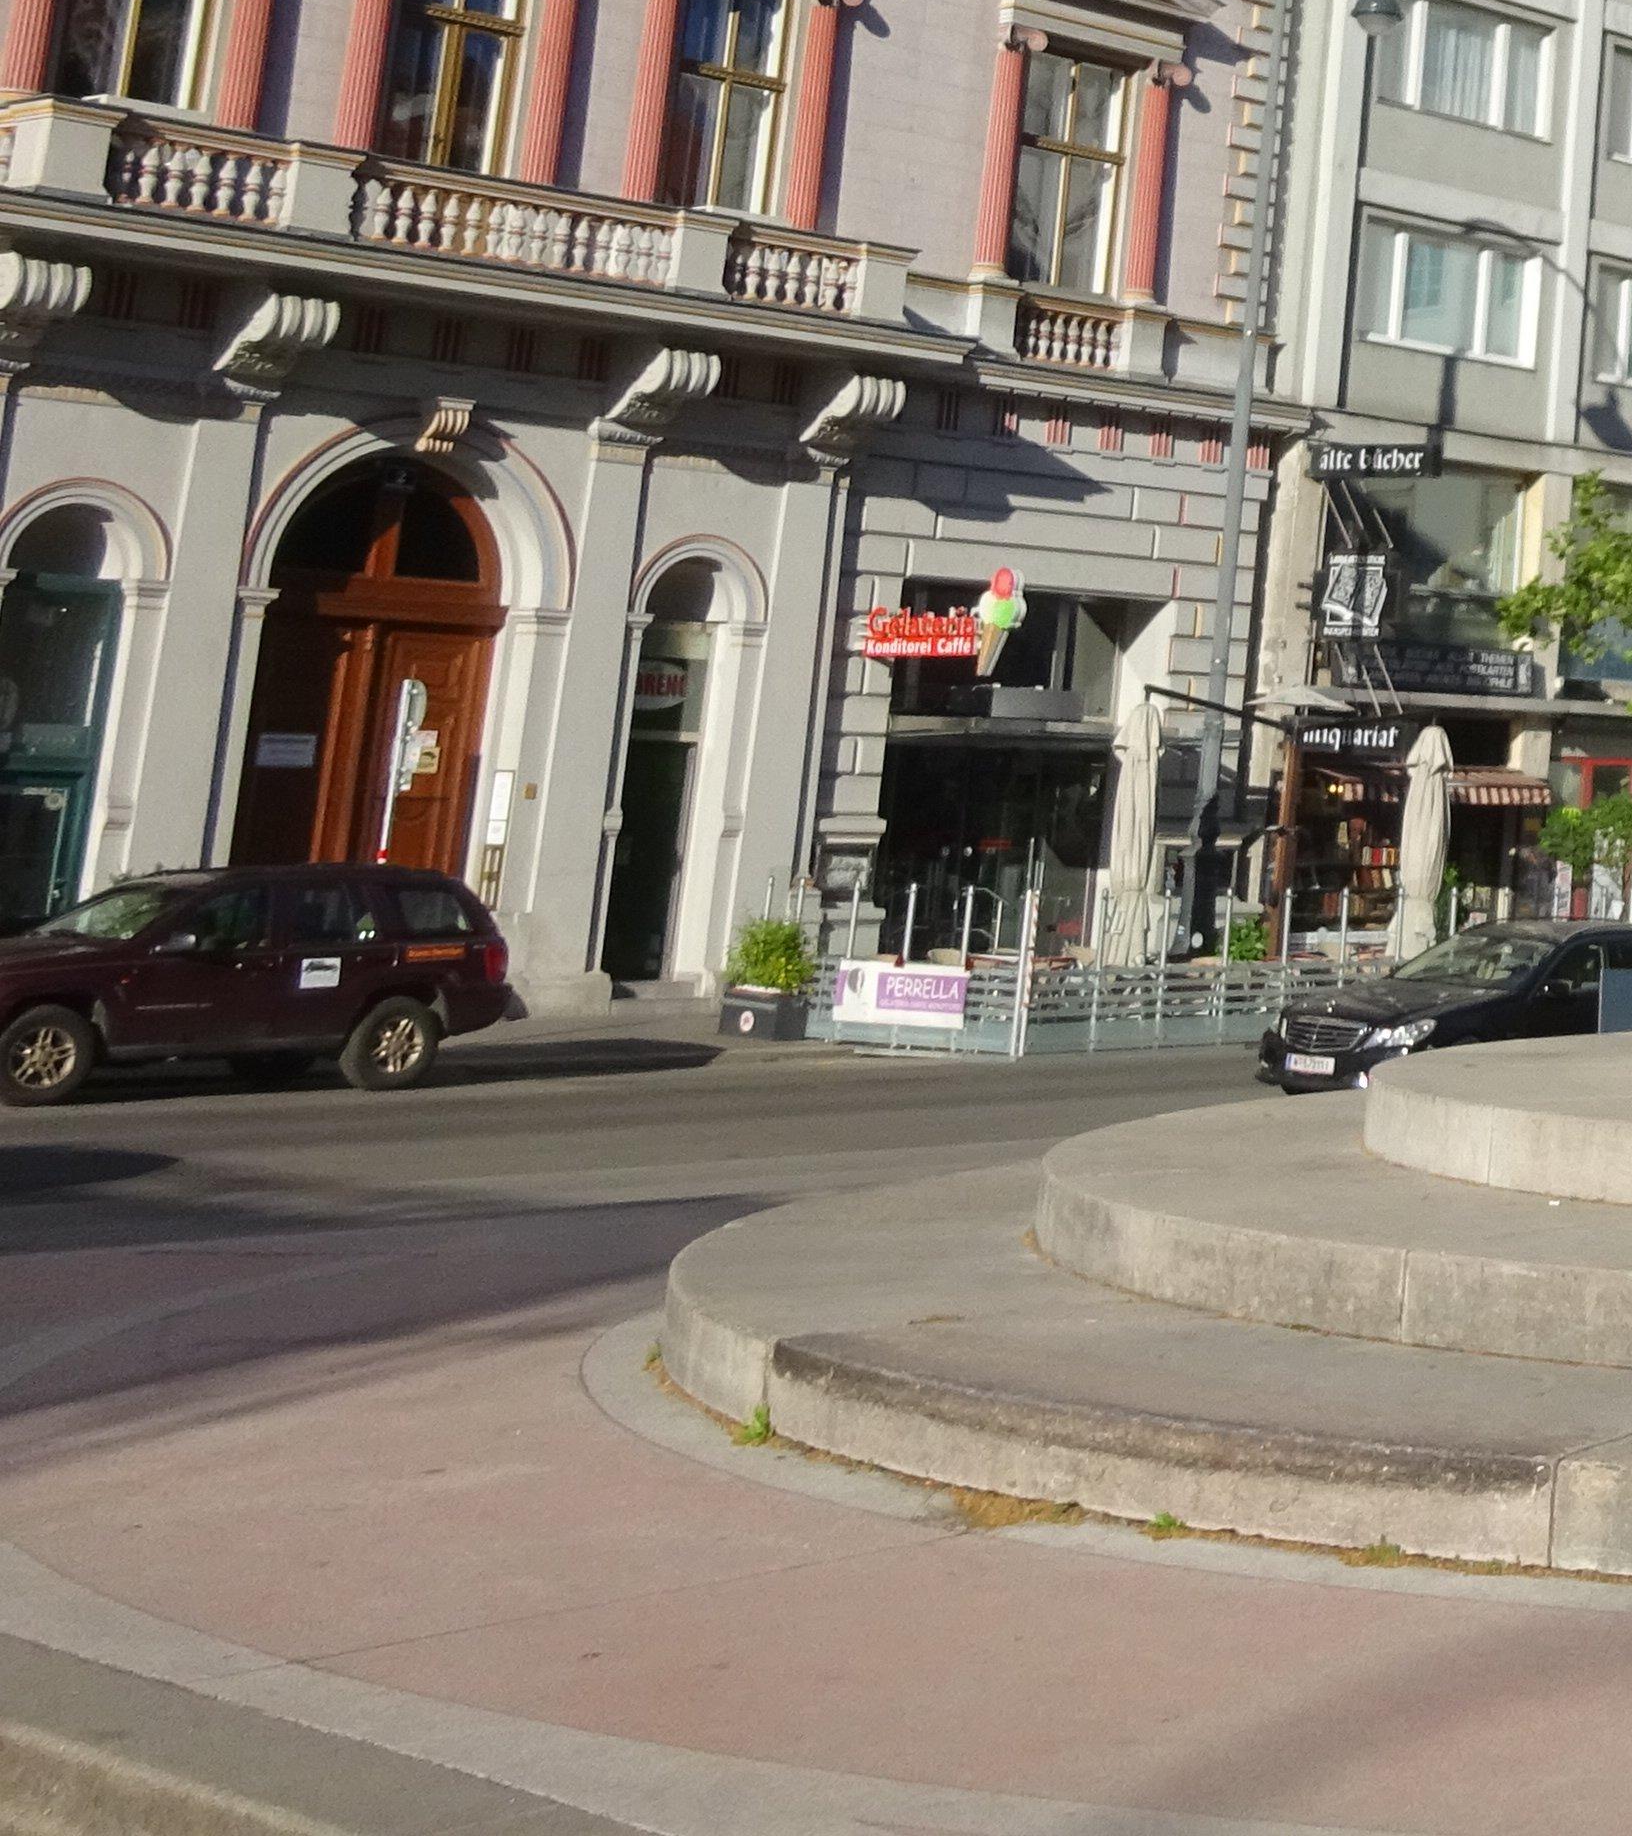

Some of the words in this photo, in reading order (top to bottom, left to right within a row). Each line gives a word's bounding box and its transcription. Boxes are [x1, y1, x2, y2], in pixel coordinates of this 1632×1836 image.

[868, 606, 976, 638] Gelateria
[866, 637, 932, 655] Konditorei
[1303, 726, 1398, 752] ntiquariat
[886, 976, 959, 1000] PERRELLA
